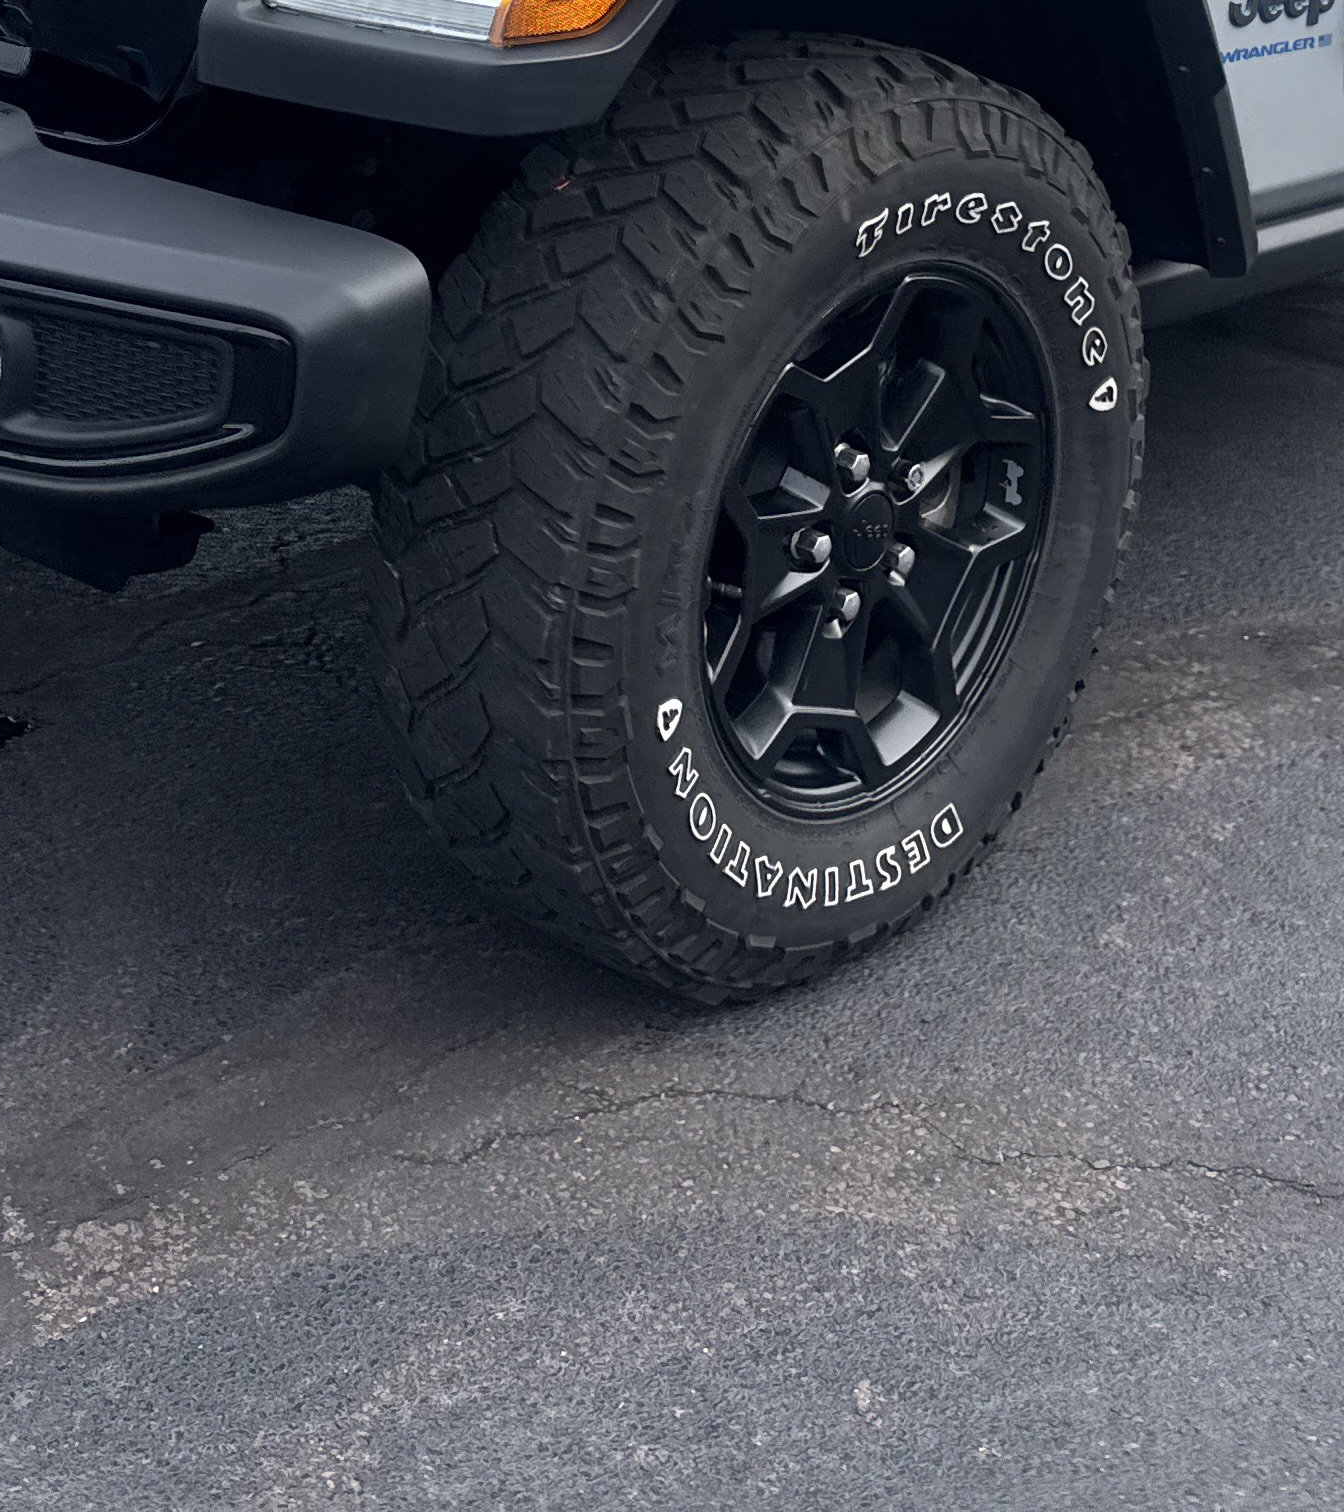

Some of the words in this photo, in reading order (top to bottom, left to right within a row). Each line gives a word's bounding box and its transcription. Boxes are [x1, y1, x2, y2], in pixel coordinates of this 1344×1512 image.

[1220, 37, 1315, 64] WRANGLER
[856, 192, 1108, 367] Firestone
[668, 746, 964, 909] DESTINATION
